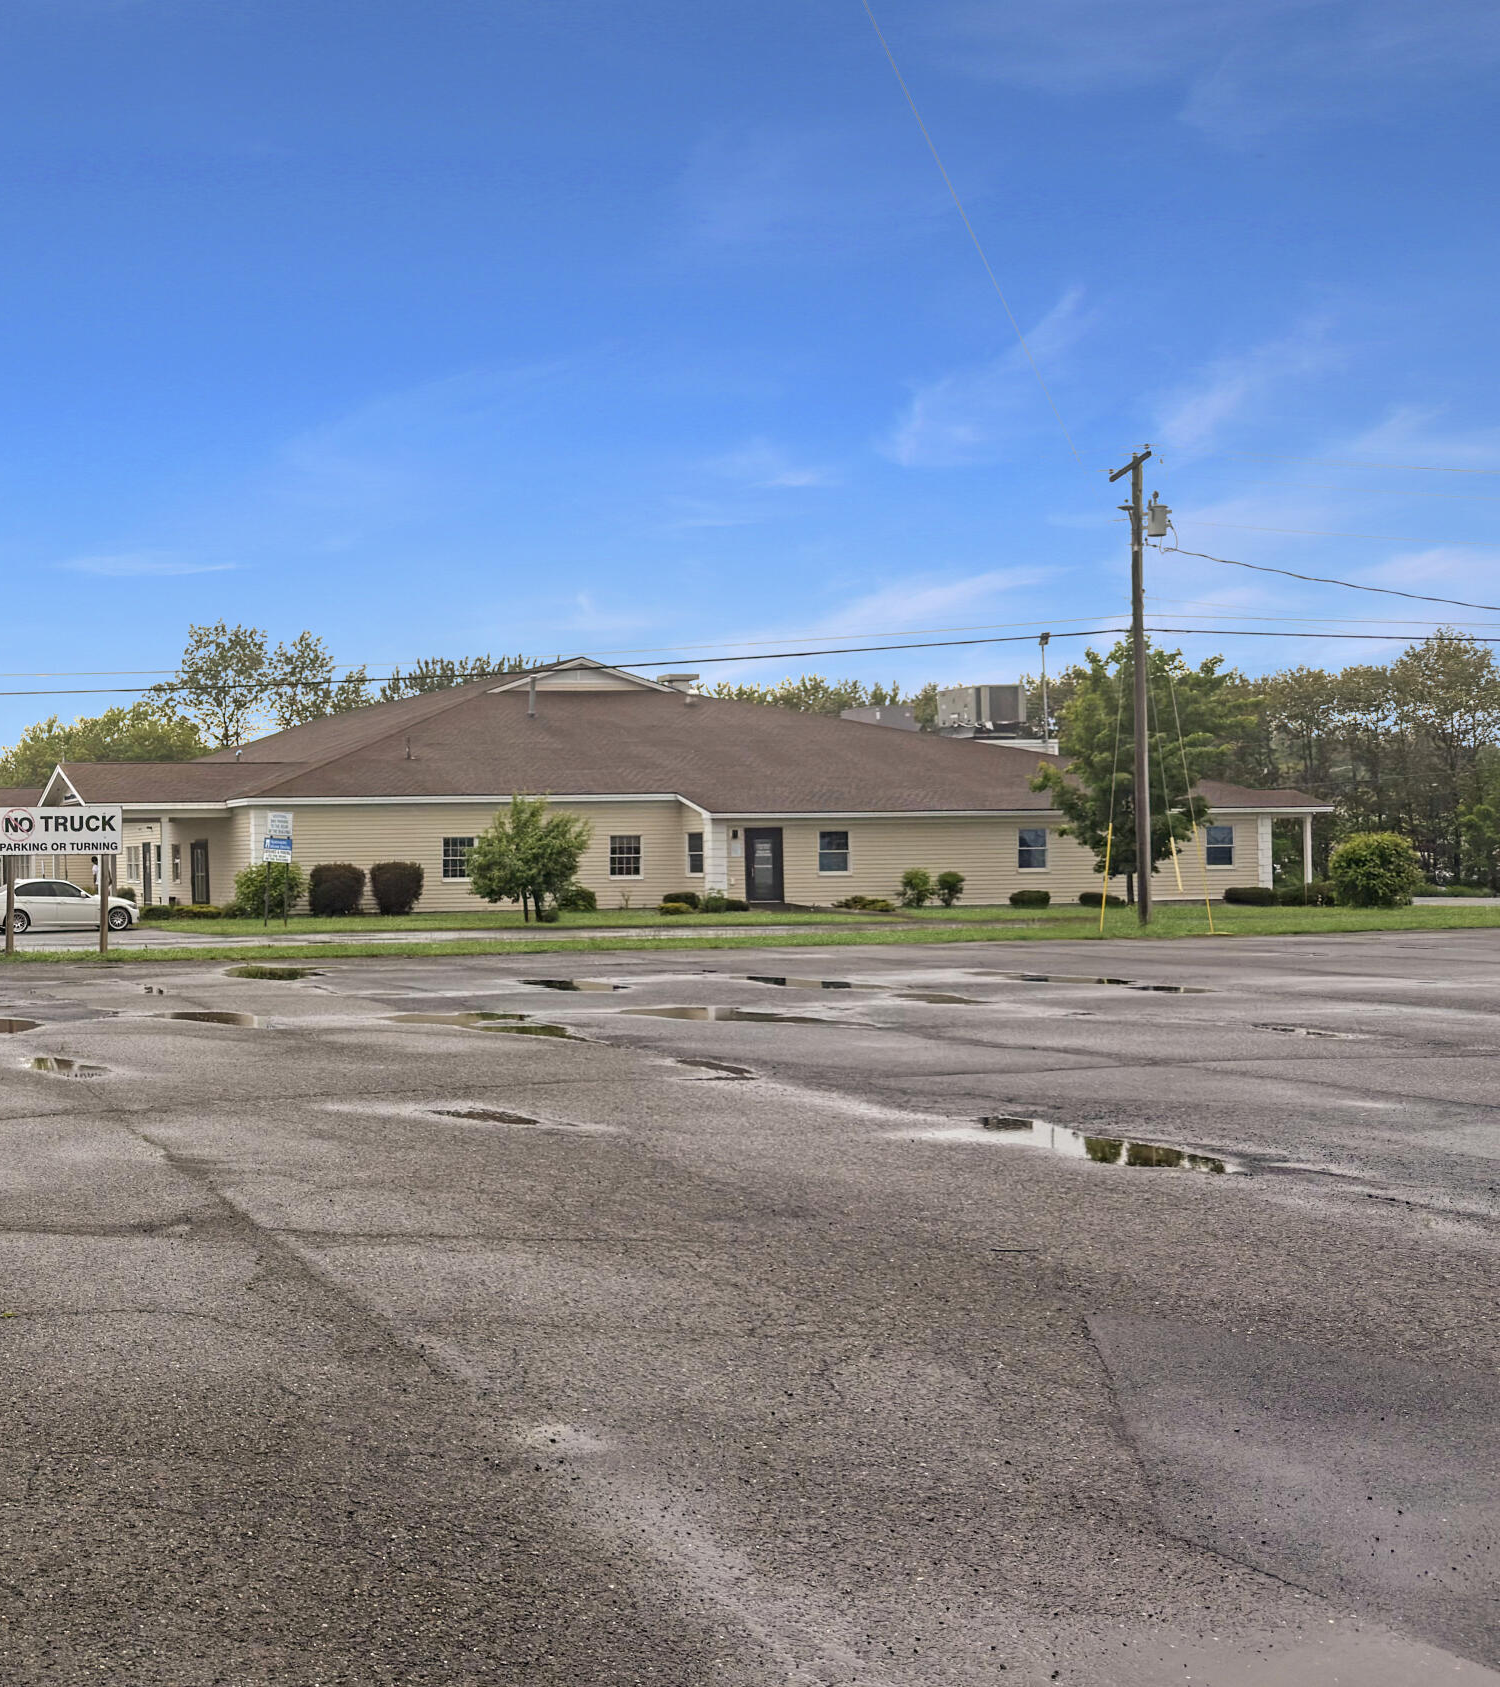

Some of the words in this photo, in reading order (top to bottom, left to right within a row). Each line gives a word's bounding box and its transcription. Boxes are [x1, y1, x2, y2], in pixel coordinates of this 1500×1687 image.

[4, 817, 34, 833] NO
[40, 815, 116, 832] TRUCK
[0, 843, 48, 852] PARKING
[51, 842, 67, 851] OR
[69, 842, 118, 851] TURNING
